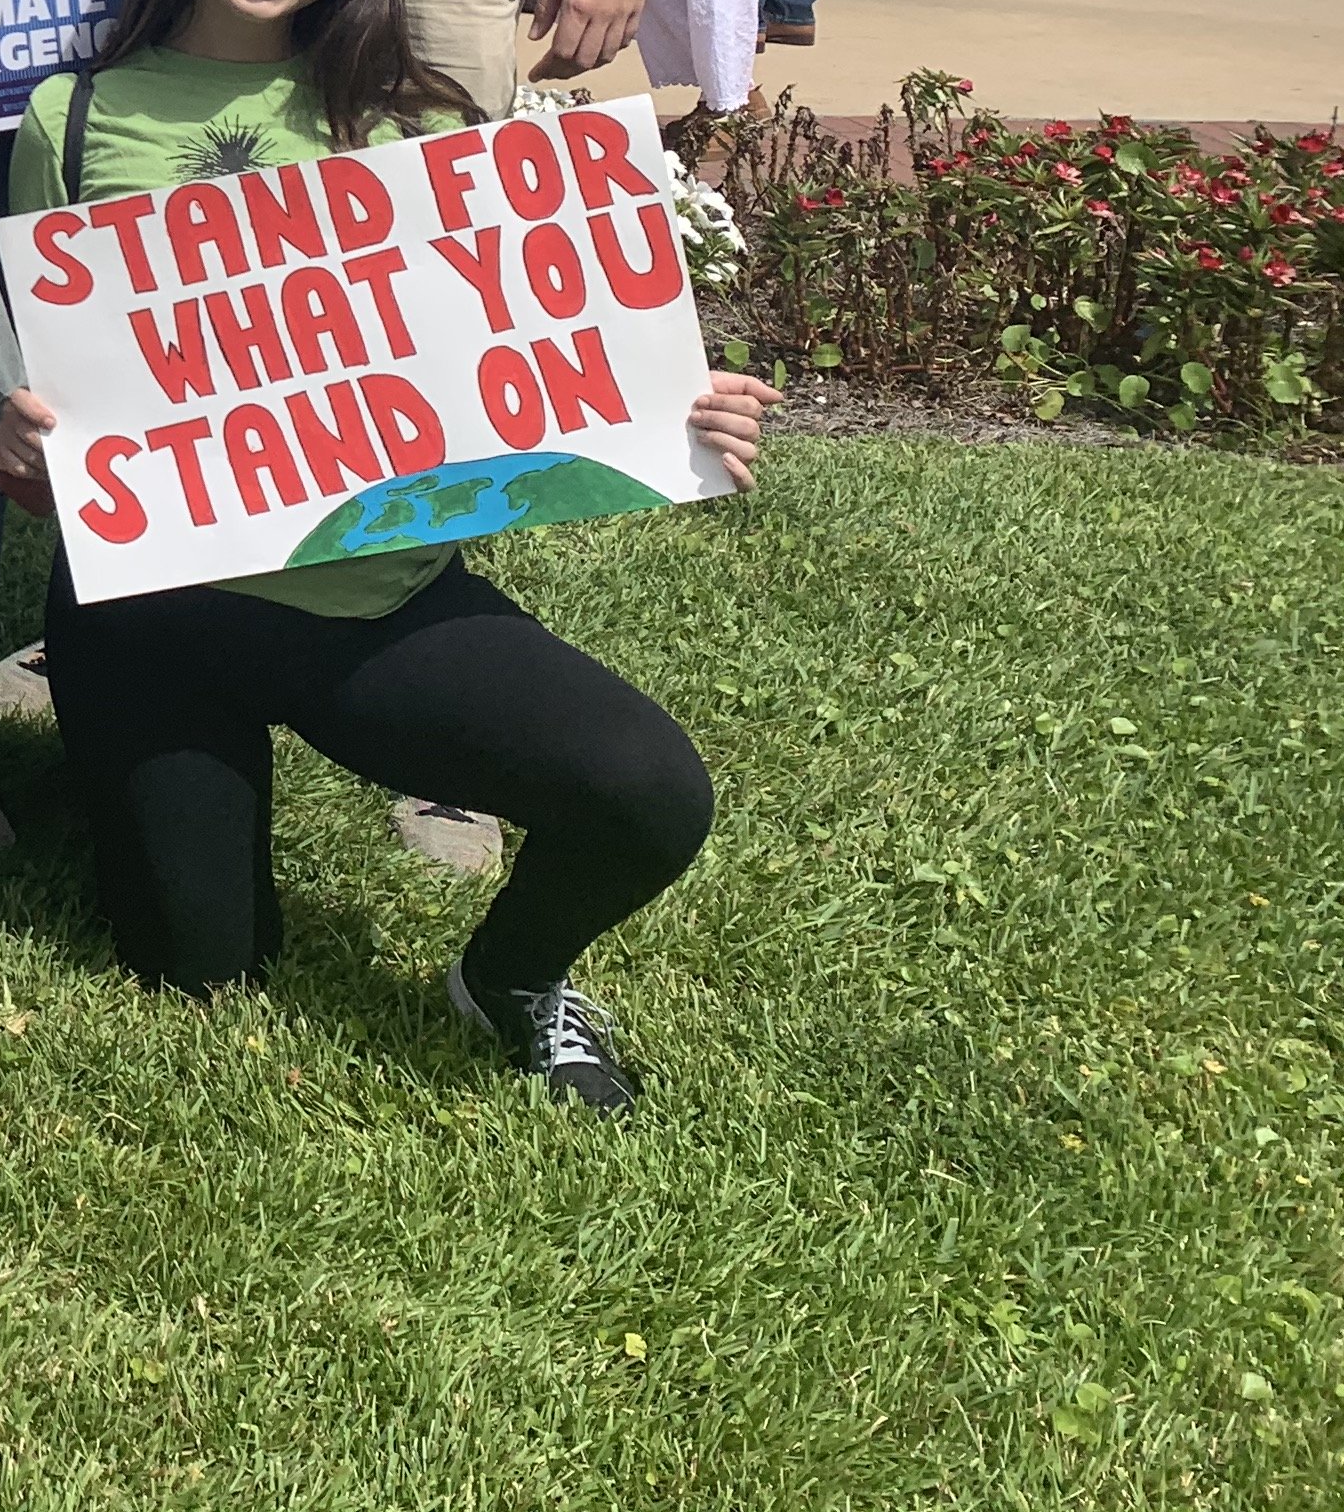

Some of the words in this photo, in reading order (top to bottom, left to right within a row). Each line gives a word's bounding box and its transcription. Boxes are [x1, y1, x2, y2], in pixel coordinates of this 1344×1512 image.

[31, 156, 395, 306] STAND
[420, 110, 658, 233] FOR
[129, 246, 416, 404] WHAT
[428, 203, 684, 333] YOU
[78, 373, 446, 544] STAND
[477, 326, 632, 450] ON
